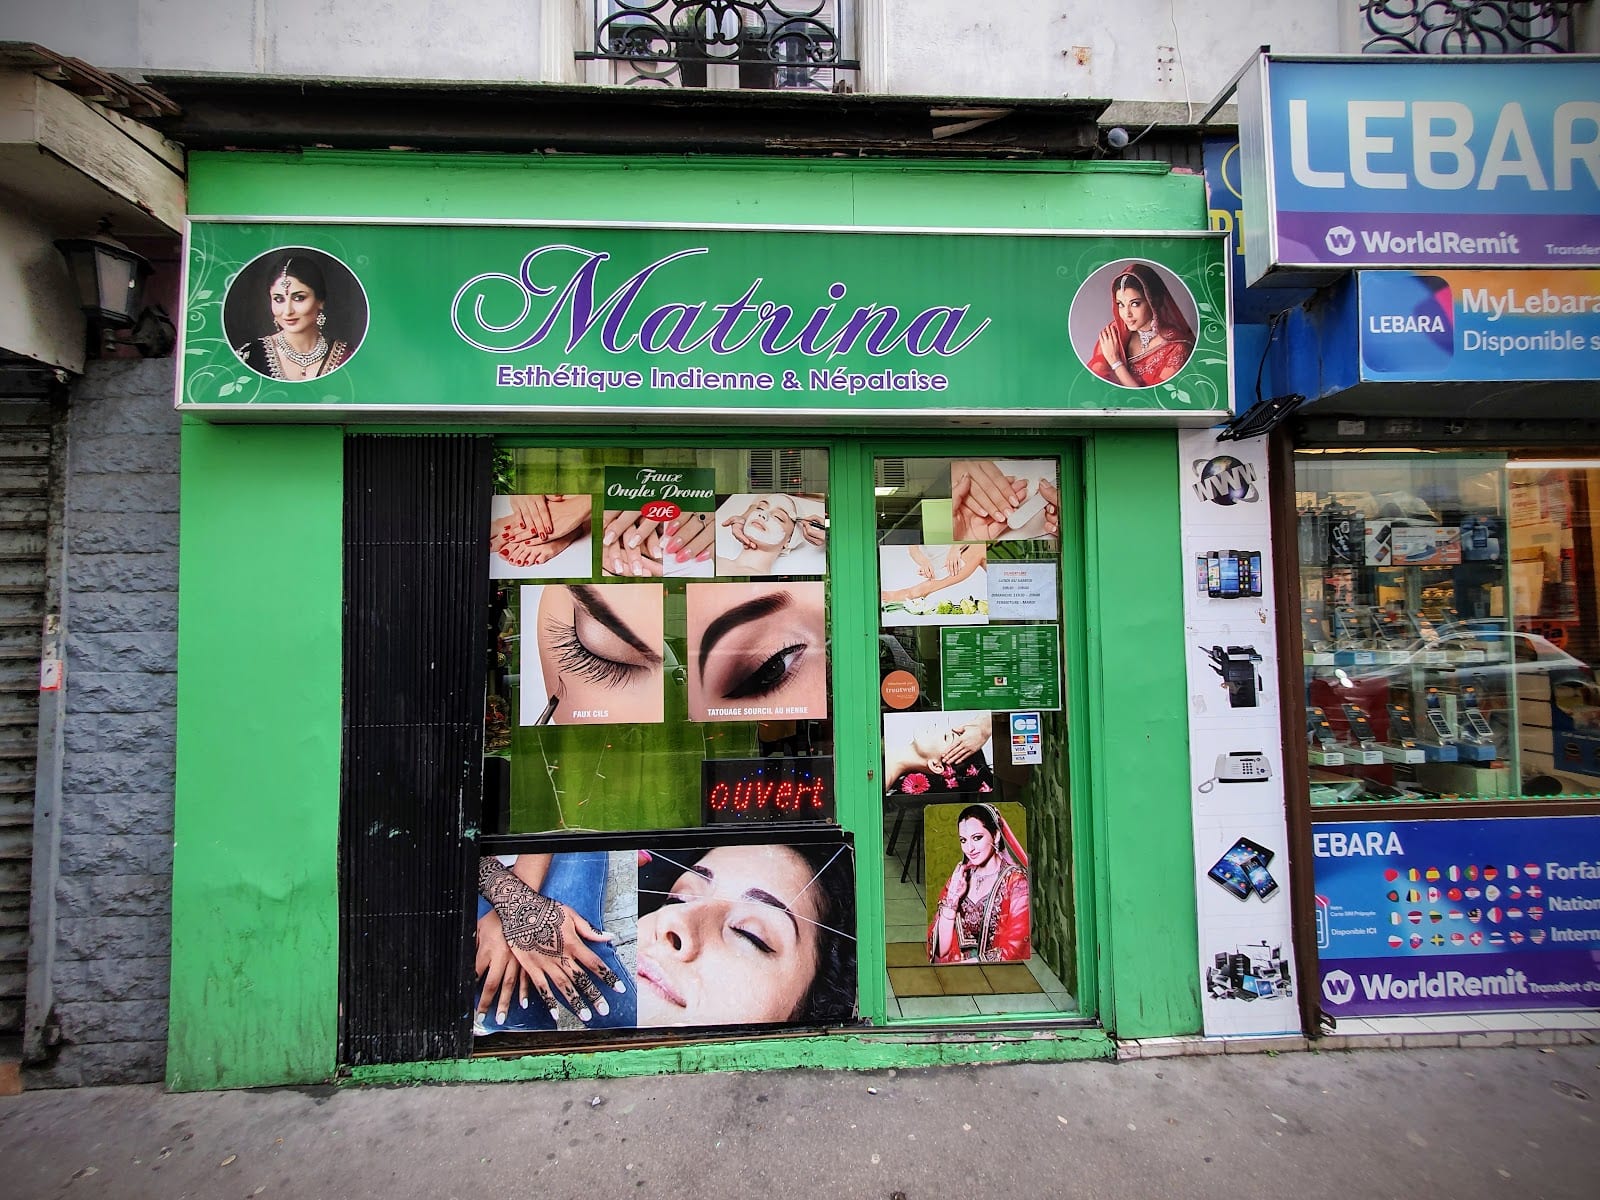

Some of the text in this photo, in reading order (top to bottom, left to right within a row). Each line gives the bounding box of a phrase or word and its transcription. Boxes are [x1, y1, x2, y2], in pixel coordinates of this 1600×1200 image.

[1289, 100, 1600, 191] LEBAR
[1361, 230, 1520, 255] WorldRemit
[450, 244, 992, 362] Matrina
[1369, 315, 1445, 334] LEBARA
[1463, 330, 1585, 356] Disponible
[496, 362, 949, 394] Esthétique Indienne & Népalaise
[636, 468, 683, 484] Faux
[607, 482, 715, 500] Ongles Promo
[646, 505, 675, 518] 20€
[572, 710, 608, 718] FAUX CILS
[707, 708, 742, 716] TATOUAGE
[743, 707, 773, 715] SOURCIL
[774, 707, 784, 715] AU
[711, 777, 824, 810] ouvert
[1313, 831, 1404, 858] EBARA
[1331, 928, 1365, 936] Disponible
[1360, 968, 1527, 1001] WorldRemit
